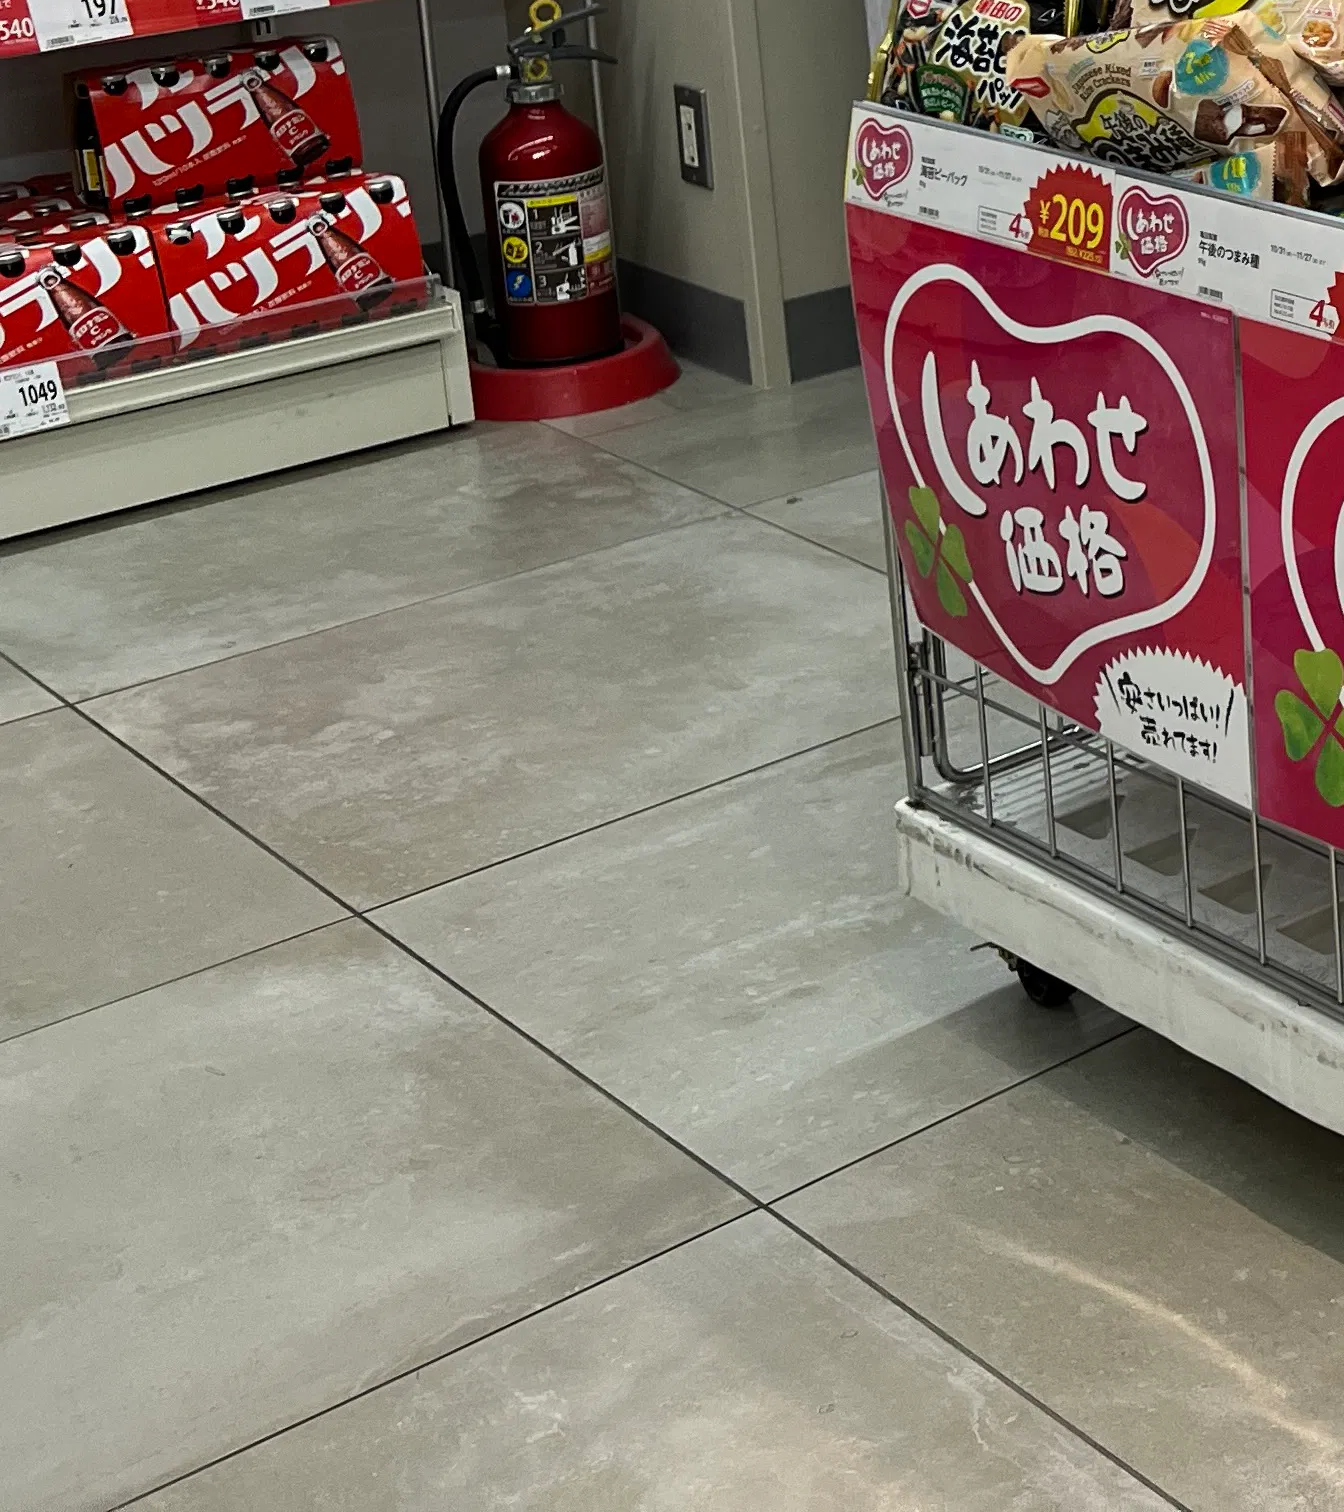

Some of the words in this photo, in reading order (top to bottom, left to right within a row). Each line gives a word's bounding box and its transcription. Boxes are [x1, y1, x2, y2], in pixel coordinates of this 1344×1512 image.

[862, 132, 901, 166] しあわせ
[1039, 194, 1104, 249] ¥209
[1128, 208, 1175, 240] しあわせ
[1198, 241, 1260, 269] 午後のつまみ種
[18, 380, 58, 407] 1049
[922, 351, 1148, 518] しあわせ
[1000, 504, 1127, 597] 価格
